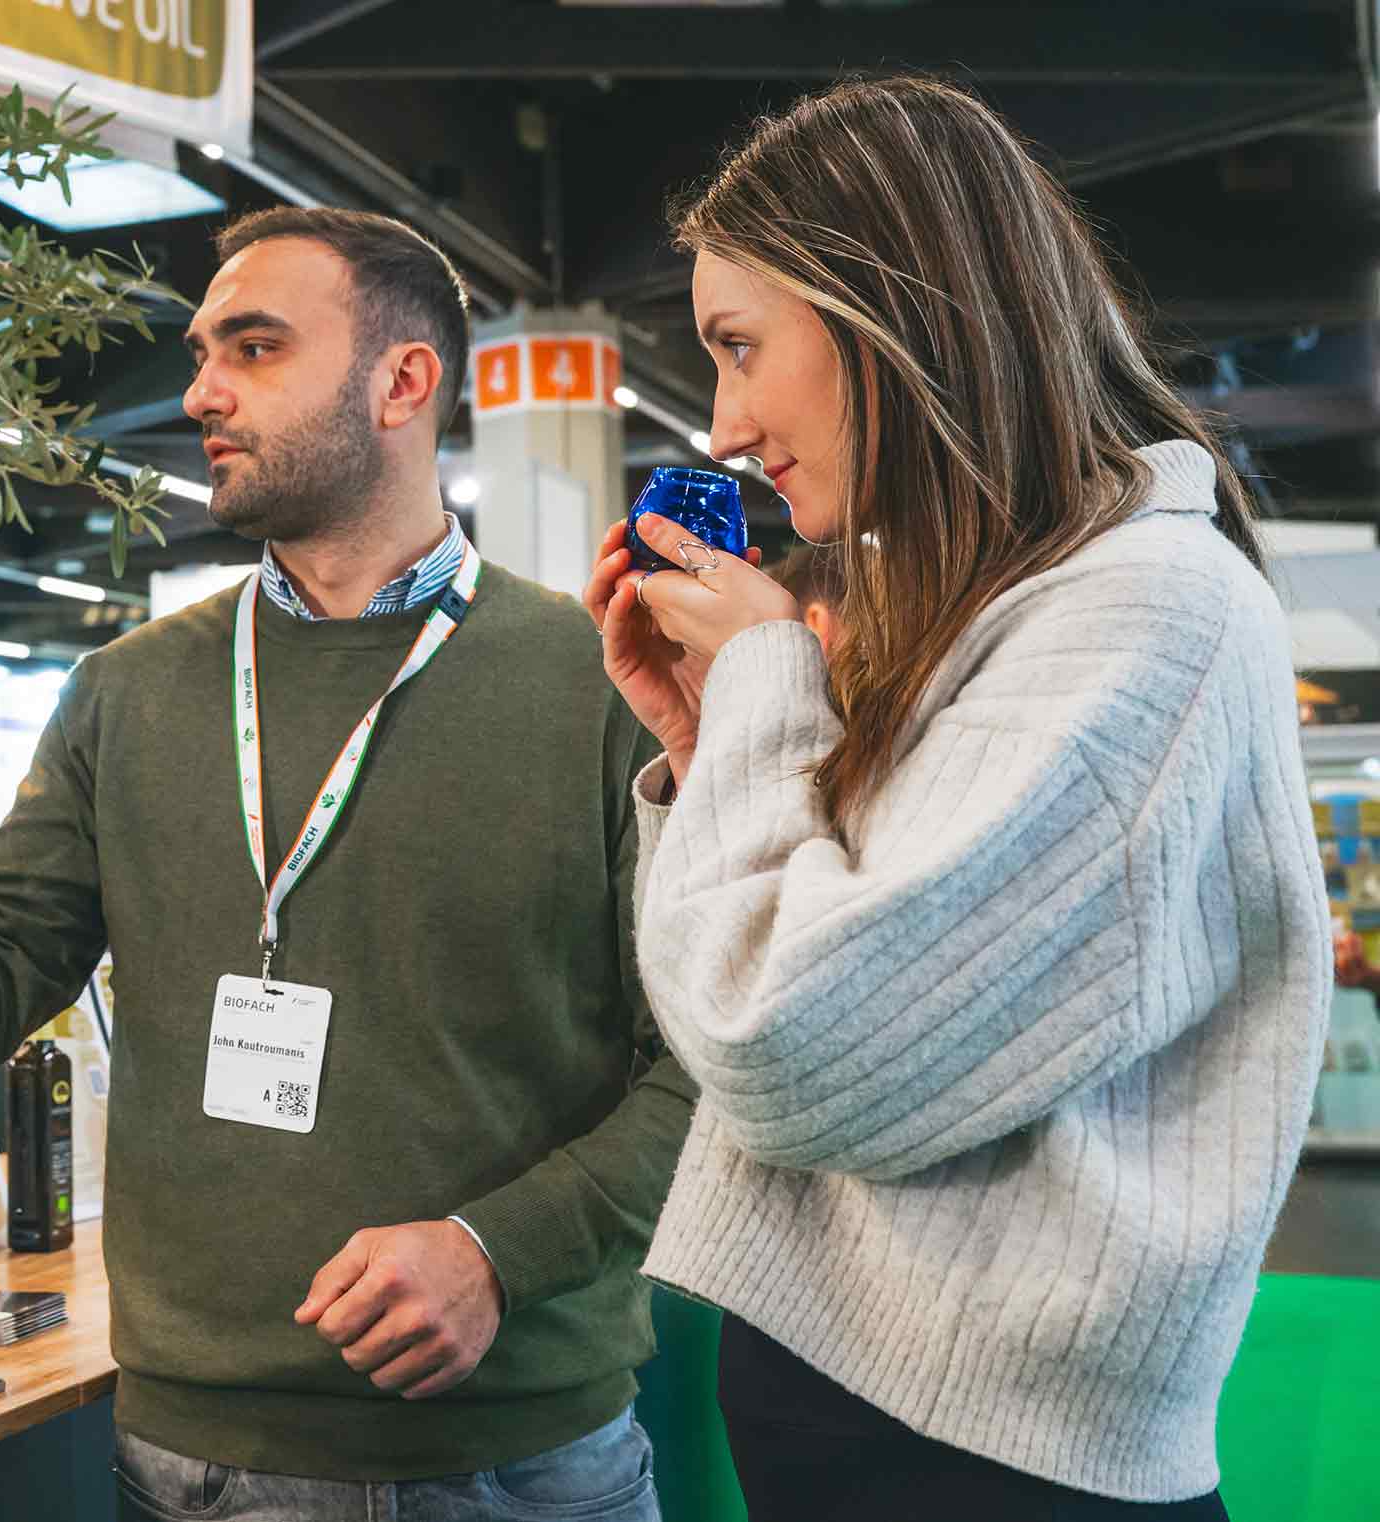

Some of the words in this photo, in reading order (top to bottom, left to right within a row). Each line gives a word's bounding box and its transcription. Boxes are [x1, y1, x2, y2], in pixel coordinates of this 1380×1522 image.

[549, 350, 577, 393] 4
[242, 667, 253, 711] BIOFACH
[286, 825, 320, 873] BIOFACH
[224, 996, 275, 1013] BIOFACH
[213, 1035, 235, 1048] John
[263, 1089, 271, 1102] A
